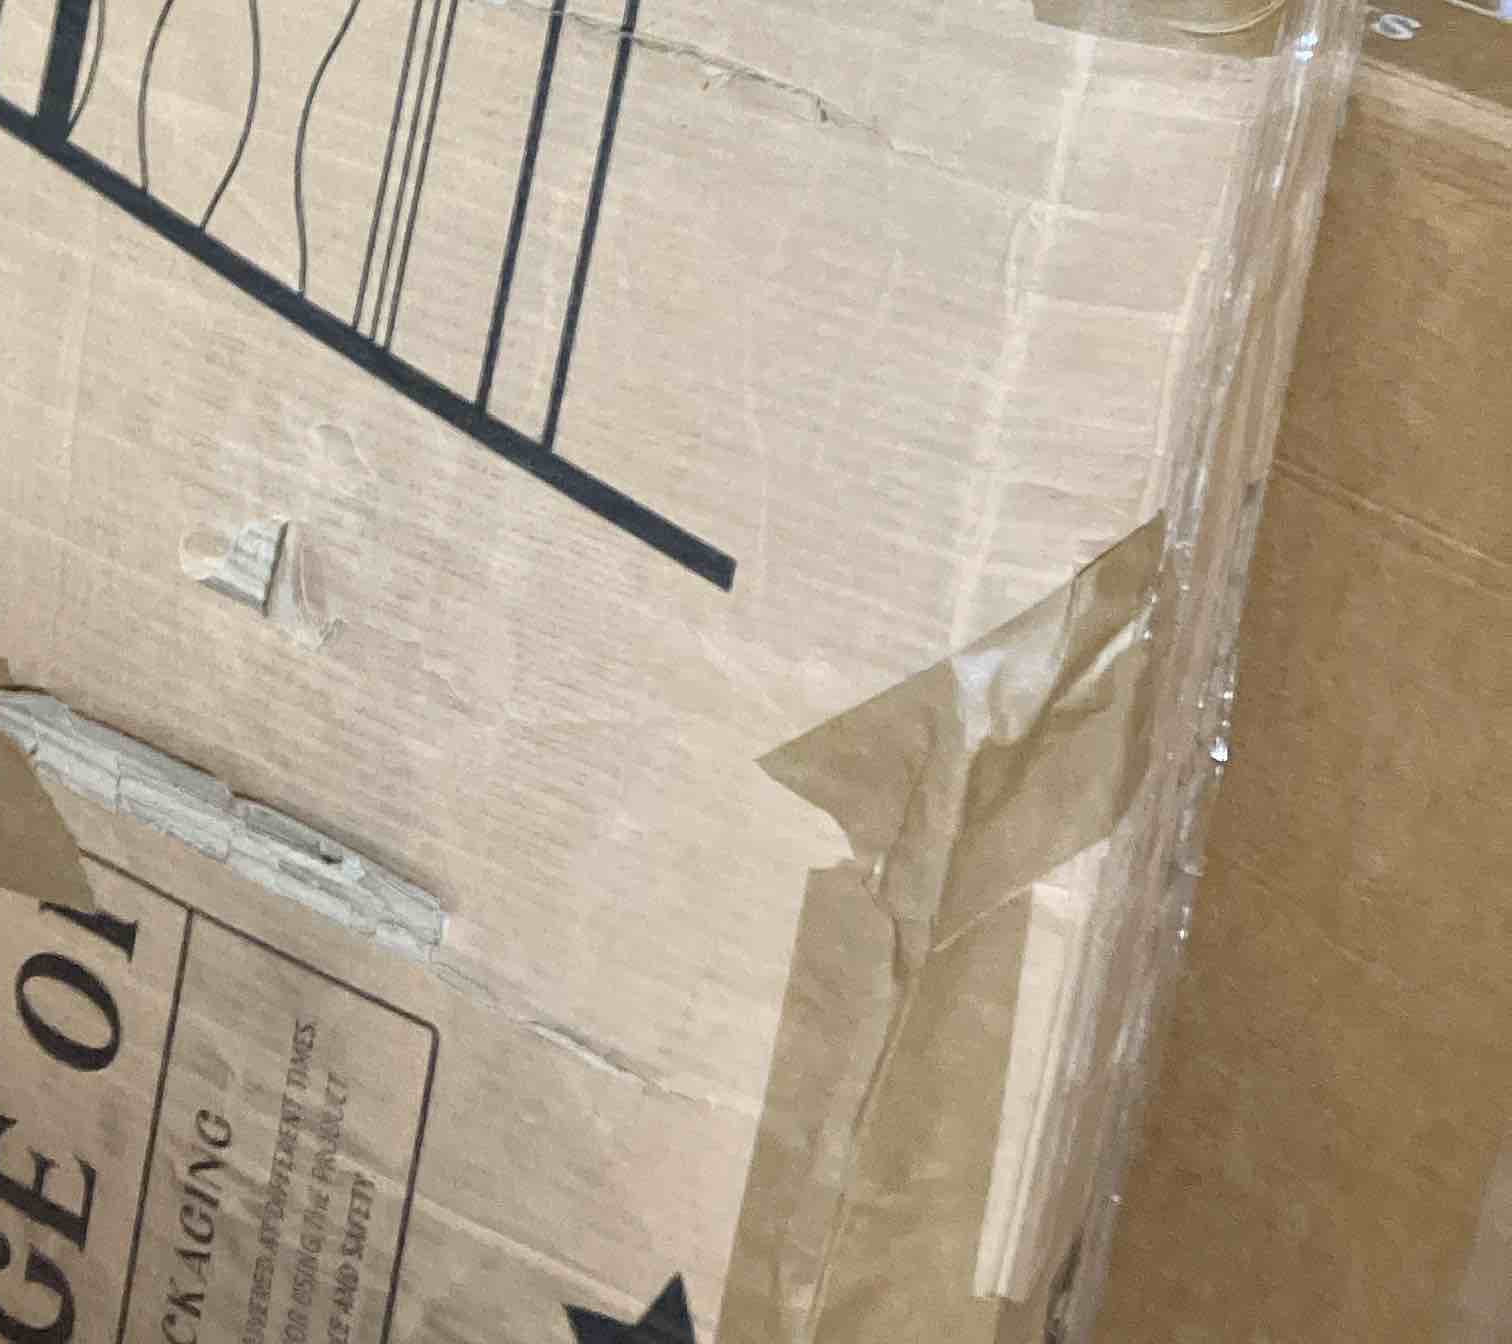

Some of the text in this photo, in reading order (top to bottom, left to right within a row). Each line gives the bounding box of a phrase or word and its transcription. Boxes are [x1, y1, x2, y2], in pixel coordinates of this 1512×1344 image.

[261, 1092, 301, 1219] DIFFERENT
[340, 1175, 375, 1261] SAFETY
[291, 1233, 324, 1306] USING
[333, 1264, 359, 1314] AND
